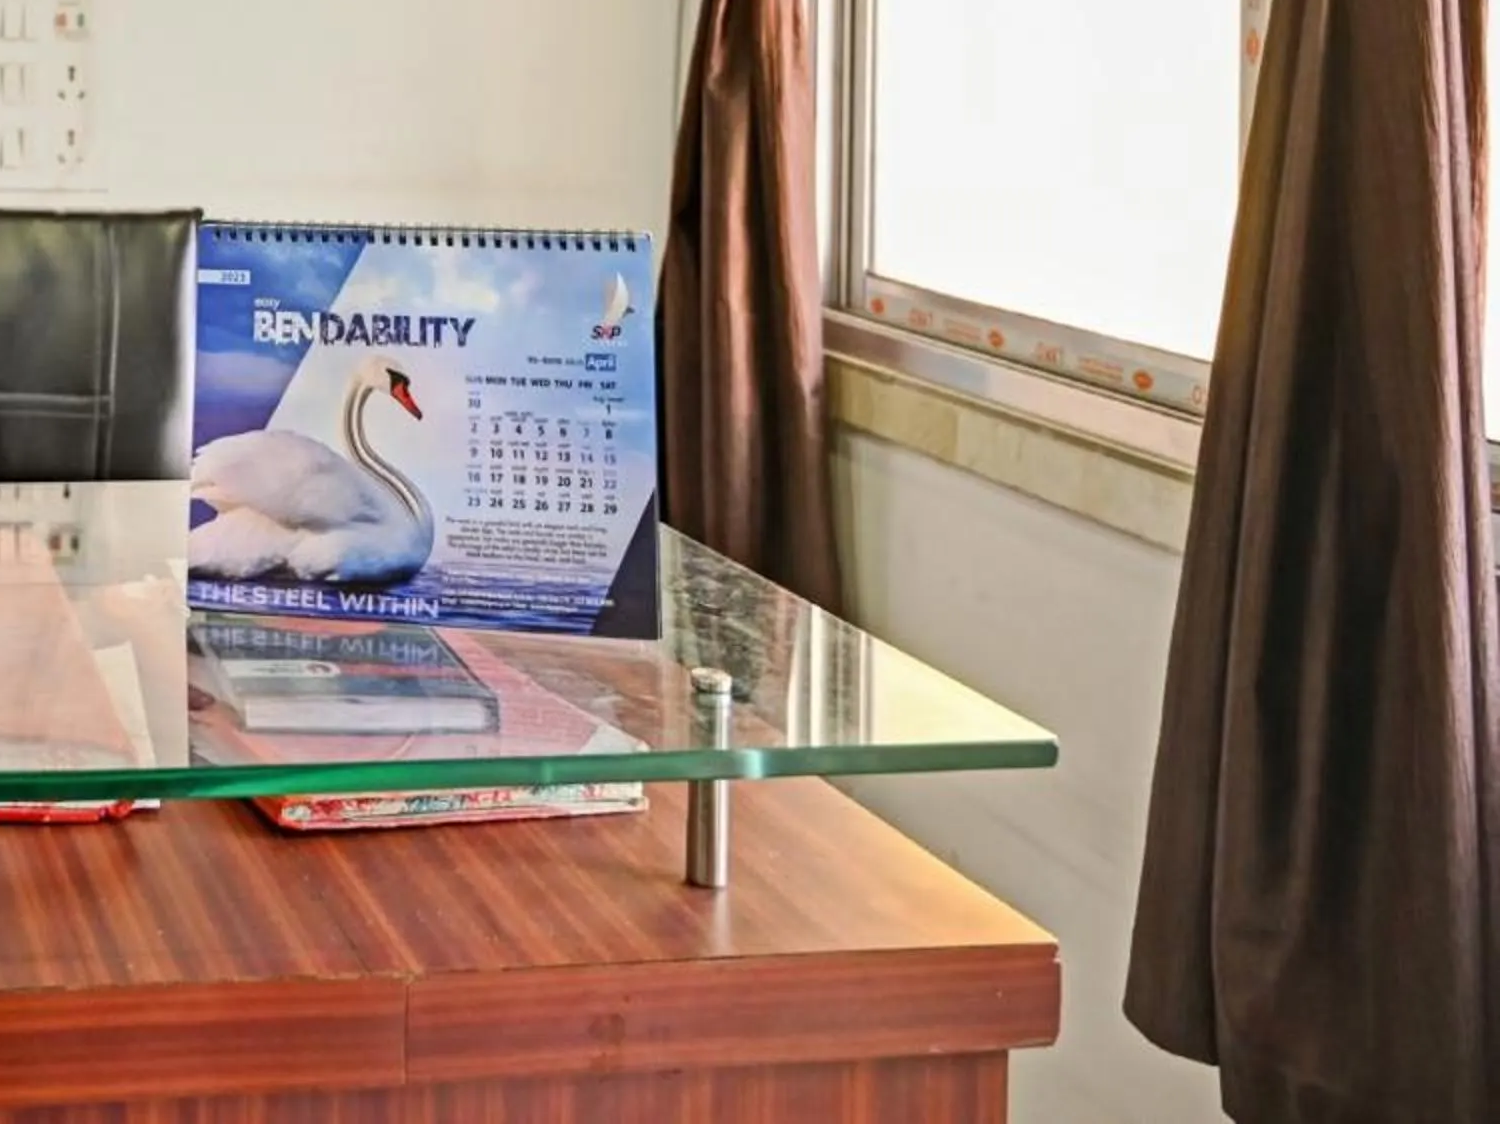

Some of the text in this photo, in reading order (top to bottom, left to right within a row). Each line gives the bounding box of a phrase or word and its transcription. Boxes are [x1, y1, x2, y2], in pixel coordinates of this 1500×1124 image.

[253, 309, 476, 349] BENDABILITY
[587, 356, 615, 370] April
[485, 376, 507, 386] MON
[531, 378, 550, 387] WED
[554, 379, 573, 389] THU
[489, 448, 503, 459] 10
[512, 449, 526, 460] 11
[534, 450, 549, 461] 12
[489, 472, 503, 484] 17
[556, 476, 571, 488] 20
[579, 477, 594, 489] 21
[489, 497, 504, 508] 24
[512, 498, 527, 510] 25
[534, 499, 549, 511] 26
[557, 500, 571, 513] 27
[579, 501, 595, 514] 28
[602, 502, 618, 515] 29
[200, 582, 248, 604] THE
[248, 585, 332, 612] STEEL
[338, 591, 440, 619] WITHIN
